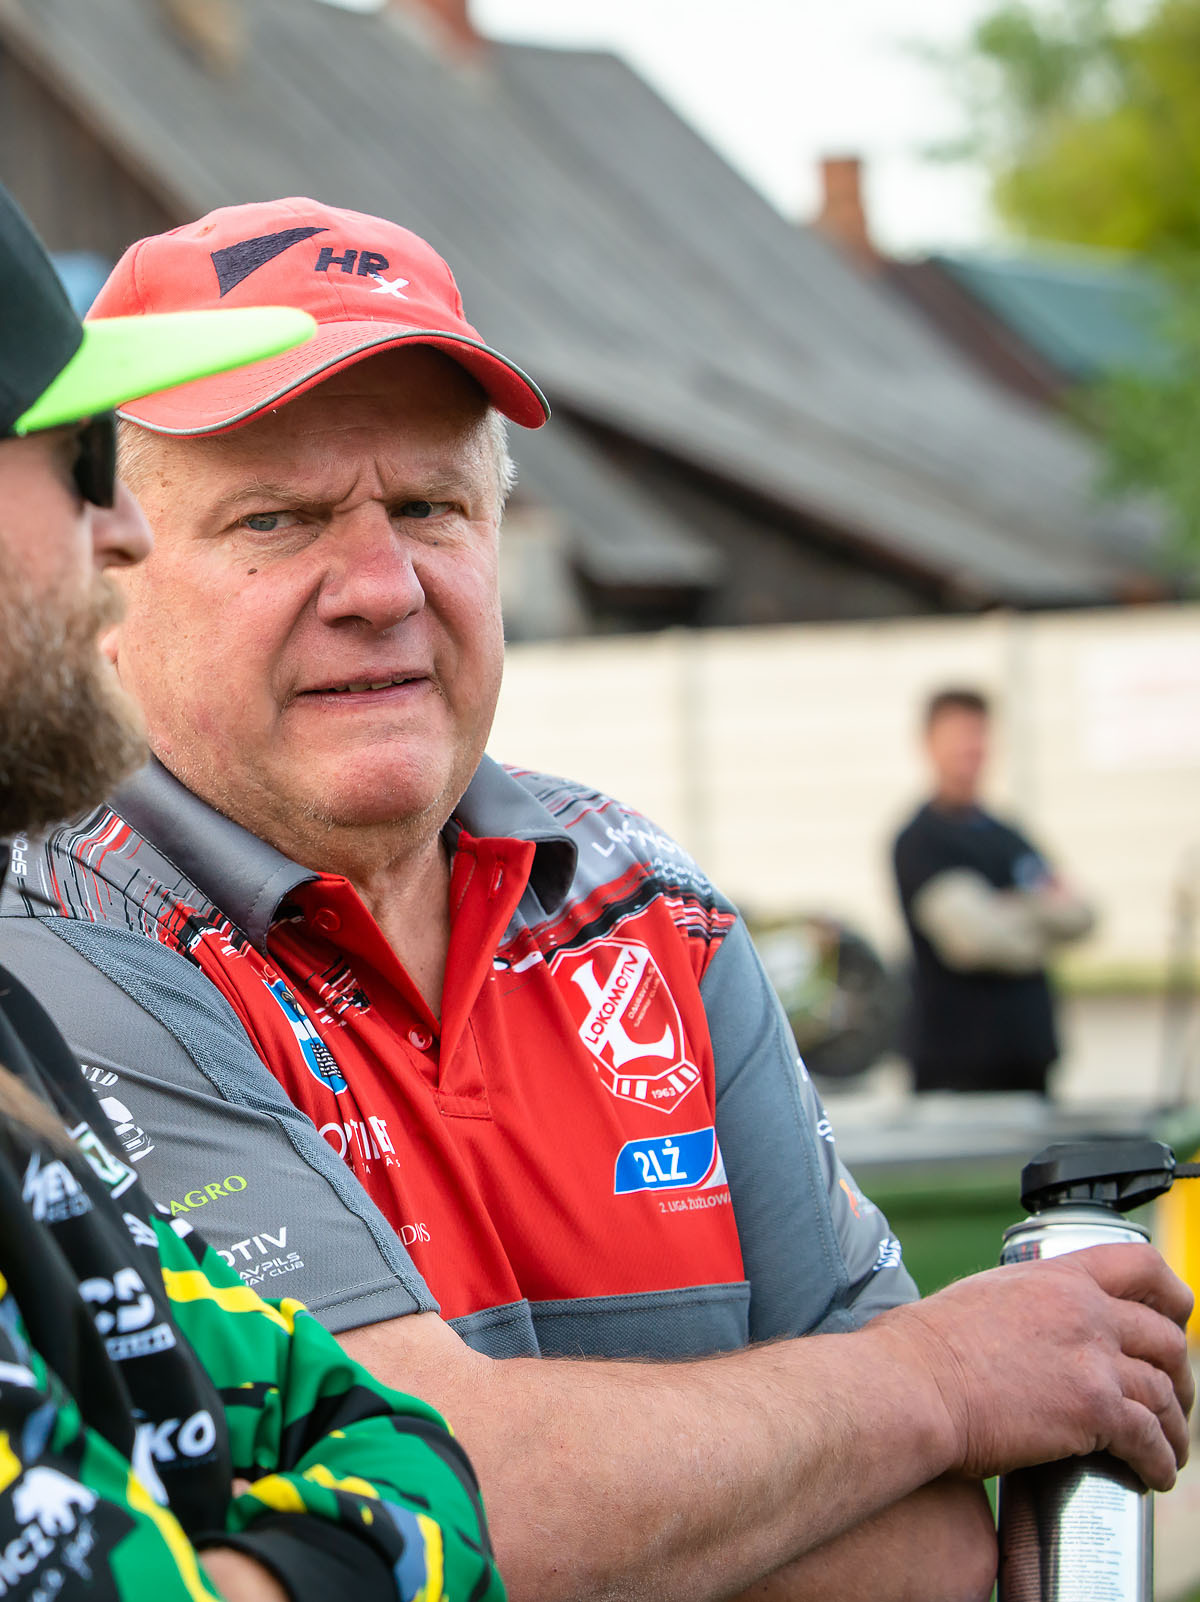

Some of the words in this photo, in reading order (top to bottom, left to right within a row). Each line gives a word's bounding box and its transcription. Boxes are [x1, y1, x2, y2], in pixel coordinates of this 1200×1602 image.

[585, 950, 639, 1045] LOKOMOTIV
[651, 1087, 676, 1099] 1963
[633, 1139, 688, 1183] 2LŻ
[169, 1175, 248, 1216] AGRO
[668, 1198, 689, 1212] LIGA
[269, 1260, 305, 1278] CLUB
